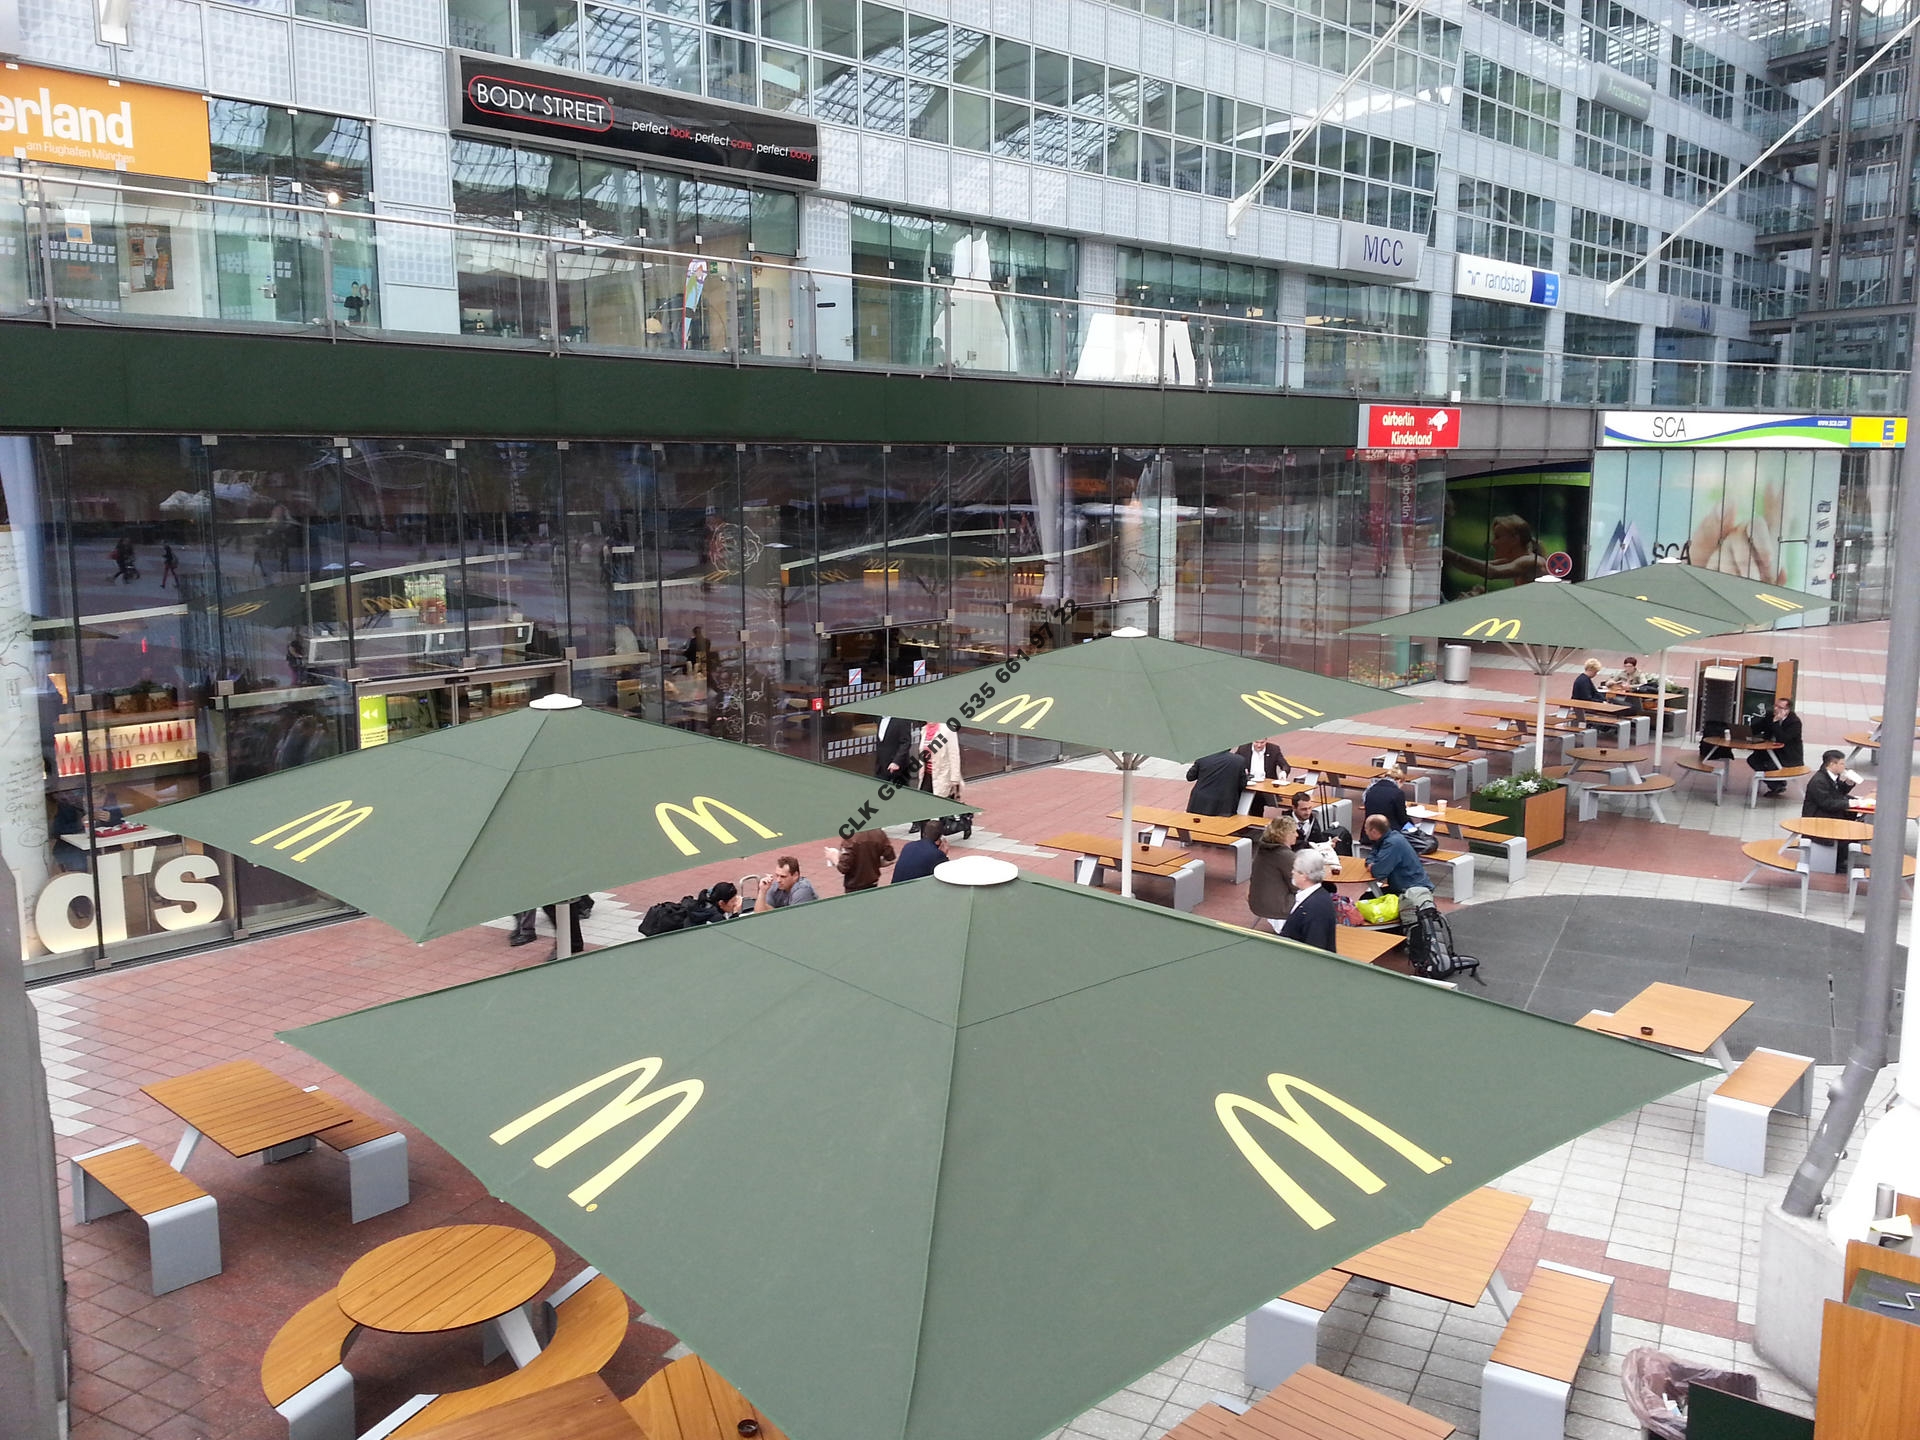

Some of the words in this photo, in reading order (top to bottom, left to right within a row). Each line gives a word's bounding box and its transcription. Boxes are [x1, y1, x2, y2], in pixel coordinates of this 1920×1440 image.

[0, 87, 134, 149] erland
[477, 83, 536, 112] BODY
[542, 95, 605, 125] STREET
[26, 141, 42, 152] am
[43, 144, 91, 158] Flughafen
[632, 120, 668, 136] perfect
[695, 131, 729, 147] perfect
[756, 142, 789, 157] perfect
[1363, 234, 1404, 267] MCC
[1485, 270, 1527, 294] randstad
[1382, 411, 1415, 427] airberlin
[1652, 416, 1687, 439] SCA
[1391, 431, 1432, 445] Kinderland
[1402, 475, 1412, 518] airberlin
